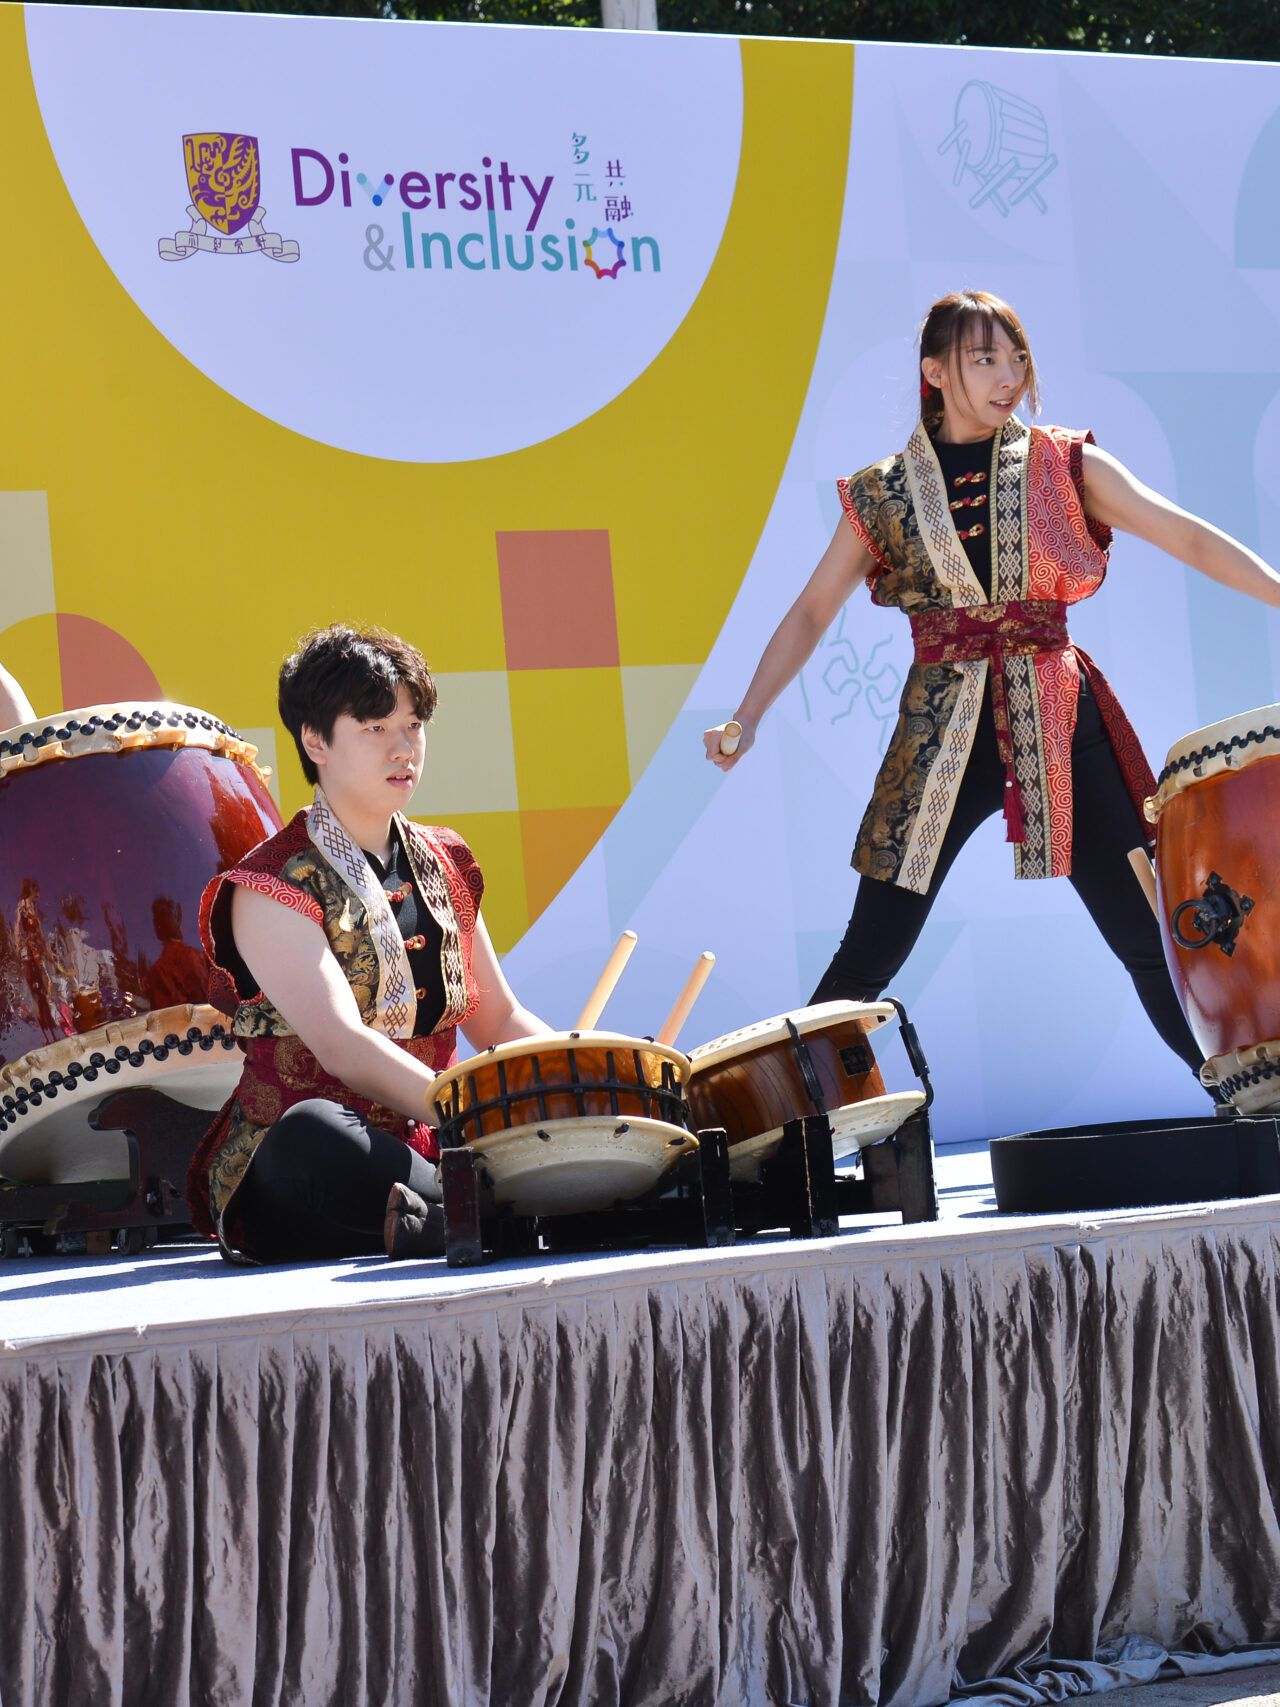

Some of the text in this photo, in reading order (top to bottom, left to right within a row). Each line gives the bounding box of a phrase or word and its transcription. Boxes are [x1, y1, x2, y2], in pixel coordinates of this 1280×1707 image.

[291, 147, 554, 232] Diversity
[571, 132, 597, 202] 多元
[604, 159, 634, 222] 共融
